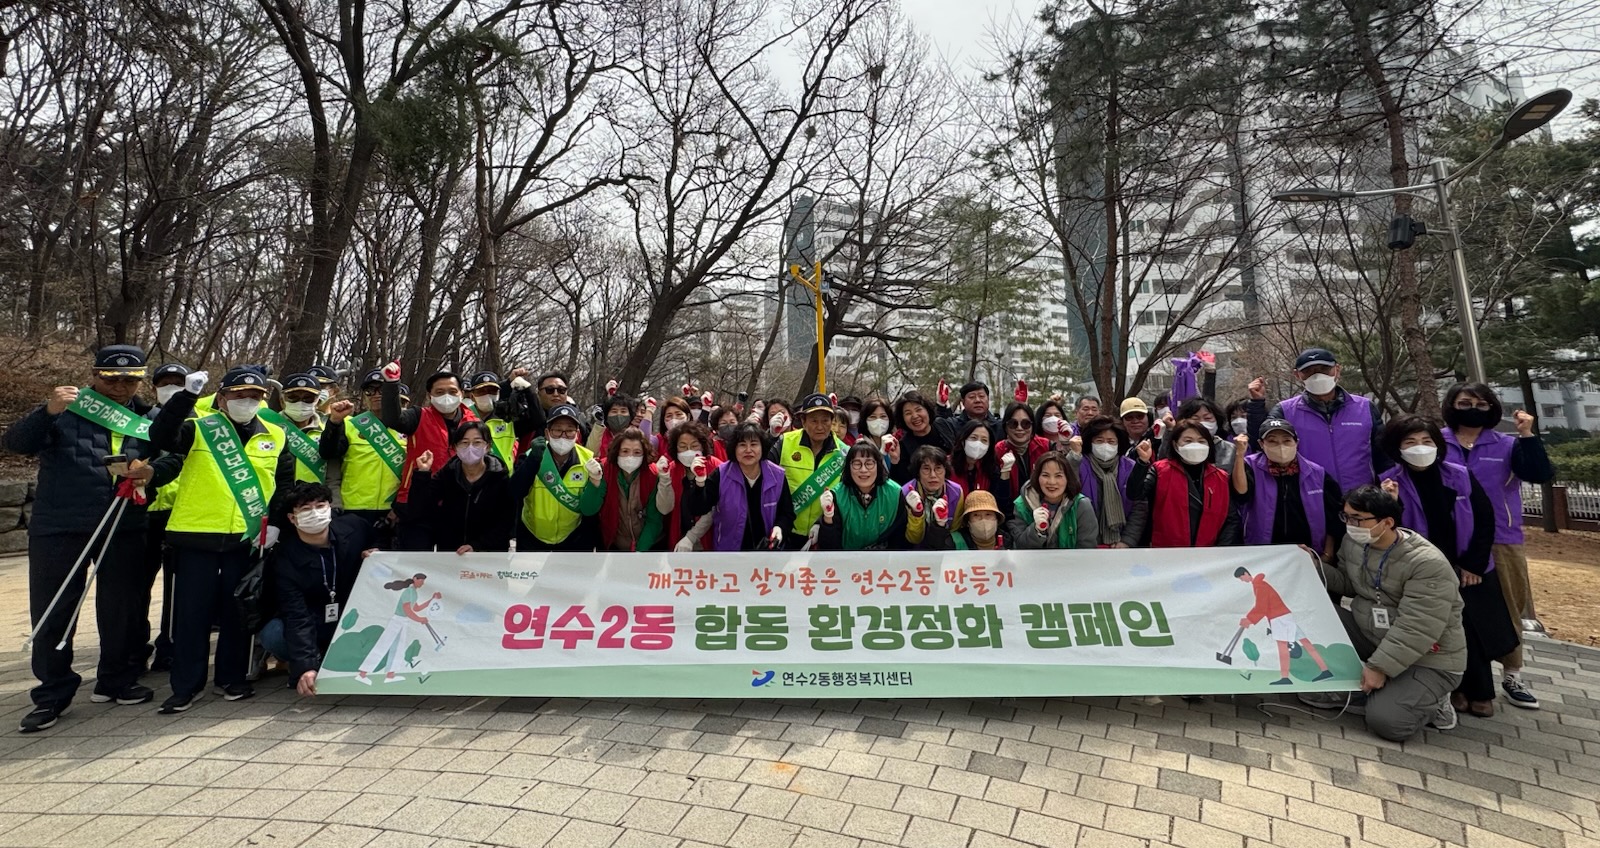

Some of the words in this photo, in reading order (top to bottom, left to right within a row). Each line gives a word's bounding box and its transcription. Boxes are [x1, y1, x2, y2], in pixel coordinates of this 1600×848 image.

[365, 422, 406, 468] 자연보호
[199, 425, 253, 485] 자연보호
[240, 485, 264, 517] 활동
[648, 568, 740, 597] 깨끗하고
[750, 566, 841, 597] 살기좋은
[851, 566, 935, 597] 연수2동
[944, 565, 1013, 596] 만들기
[501, 603, 676, 650] 연수2동
[695, 604, 789, 651] 합동
[808, 603, 1003, 651] 환경정화
[1019, 600, 1175, 649] 캠페인
[782, 671, 913, 687] 연수2동행정복지센터
